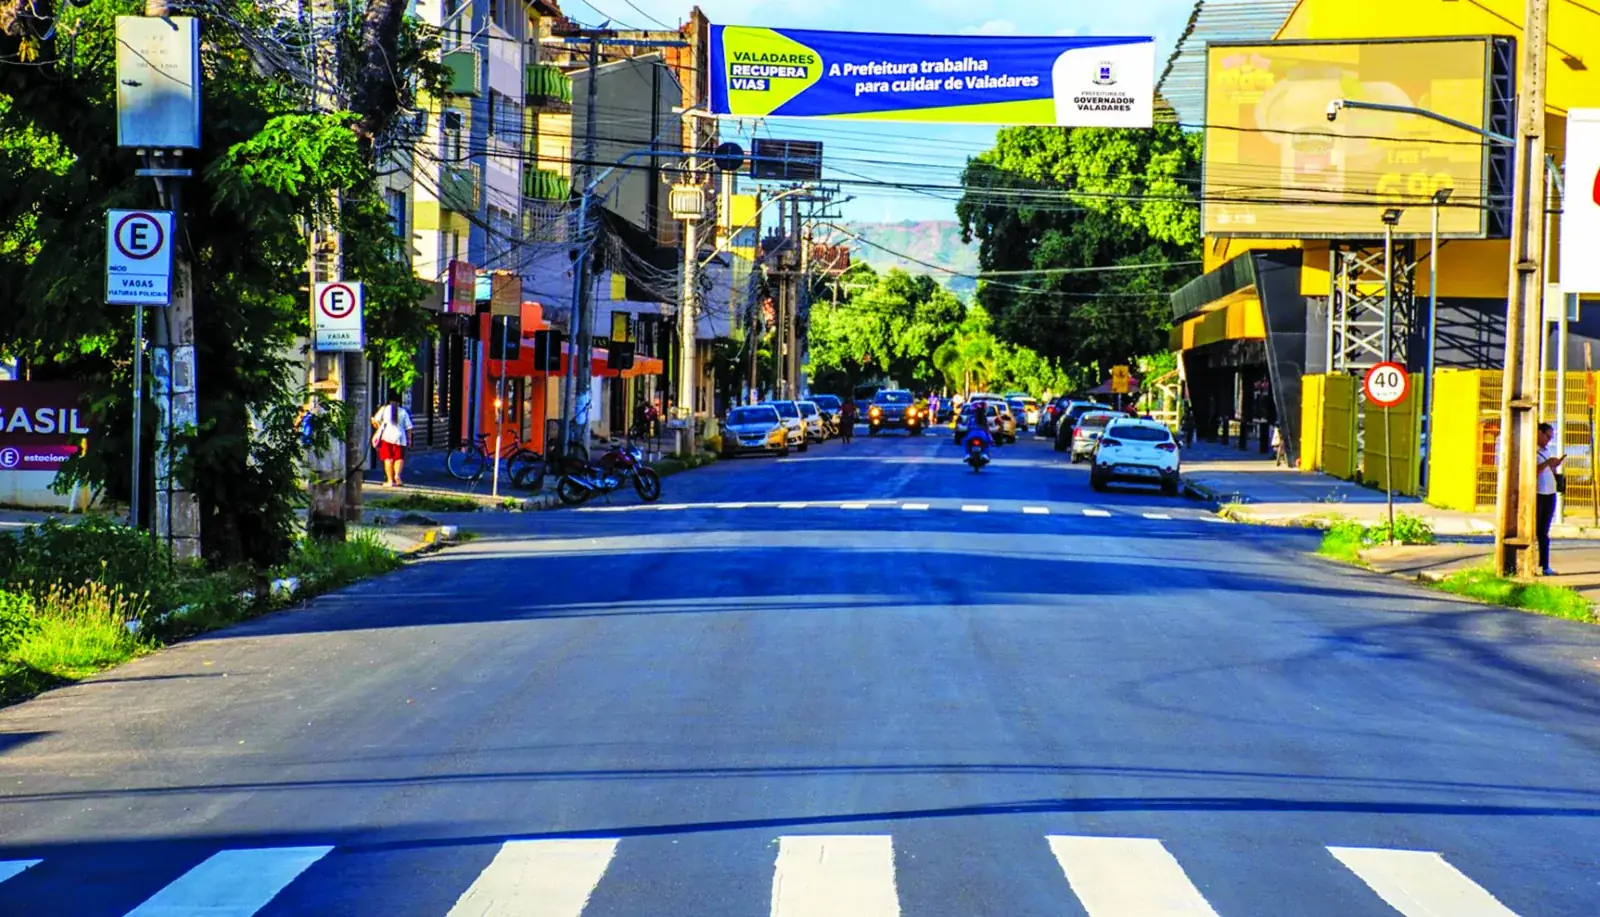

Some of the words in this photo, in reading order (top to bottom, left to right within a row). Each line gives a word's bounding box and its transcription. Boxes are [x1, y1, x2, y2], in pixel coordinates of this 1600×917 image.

[733, 51, 814, 64] VALADARES
[732, 64, 806, 78] RECUPERA
[828, 63, 841, 76] A
[843, 61, 918, 76] Prefeitura
[921, 57, 988, 73] trabalha
[732, 78, 765, 90] VIAS
[855, 80, 889, 97] para
[891, 77, 942, 92] cuidar
[944, 76, 963, 90] de
[965, 74, 1039, 89] Valadares
[1073, 96, 1135, 104] GOVERNADOR
[1077, 104, 1131, 112] VALADARES
[130, 223, 148, 250] E
[122, 279, 154, 288] VAGAS
[331, 291, 344, 311] E
[1374, 371, 1398, 388] 40
[5, 451, 14, 464] E
